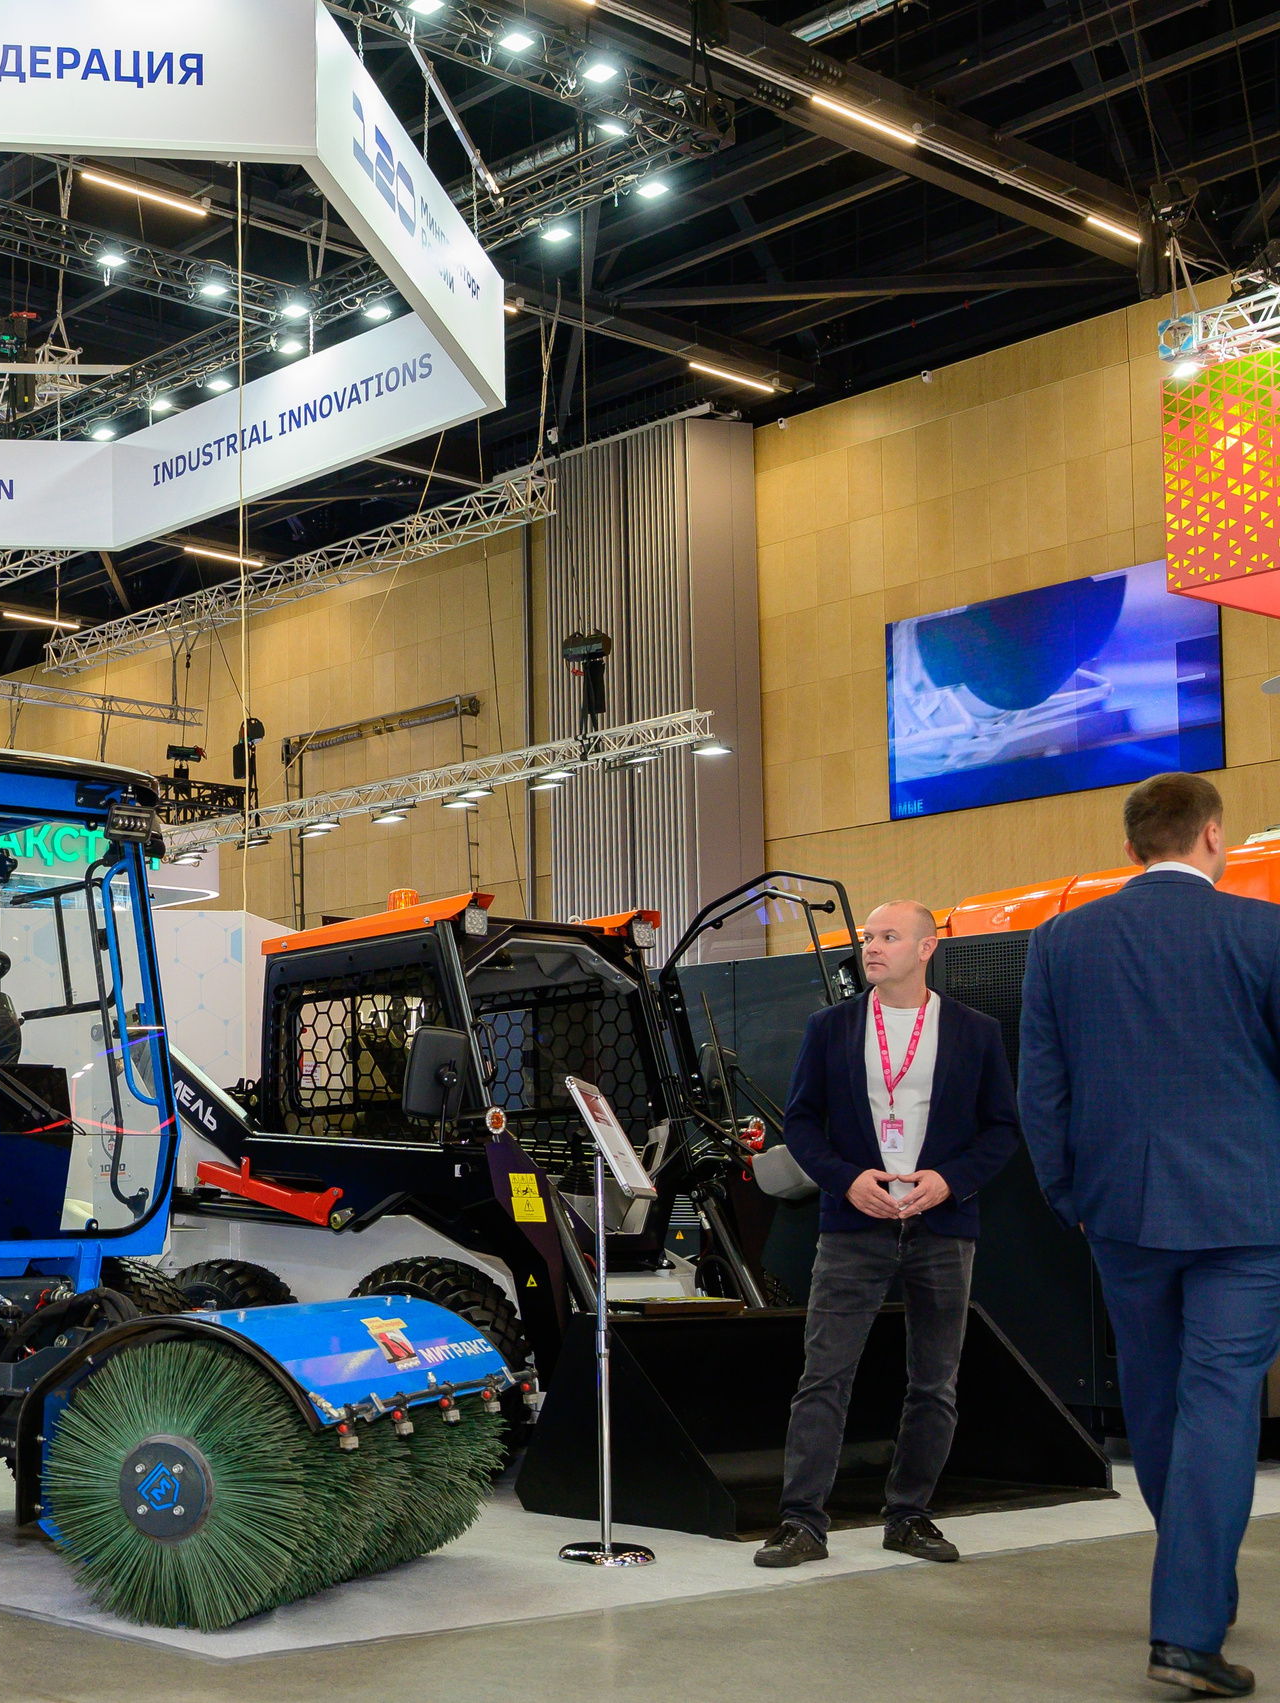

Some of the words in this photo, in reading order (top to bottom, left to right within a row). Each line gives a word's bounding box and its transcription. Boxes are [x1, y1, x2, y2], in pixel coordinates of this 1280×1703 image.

[352, 90, 417, 238] 120
[152, 426, 273, 488] INDUSTRIAL
[278, 352, 434, 437] INNOVATIONS
[100, 1163, 126, 1173] 100
[418, 1338, 494, 1364] МИТРАКС
